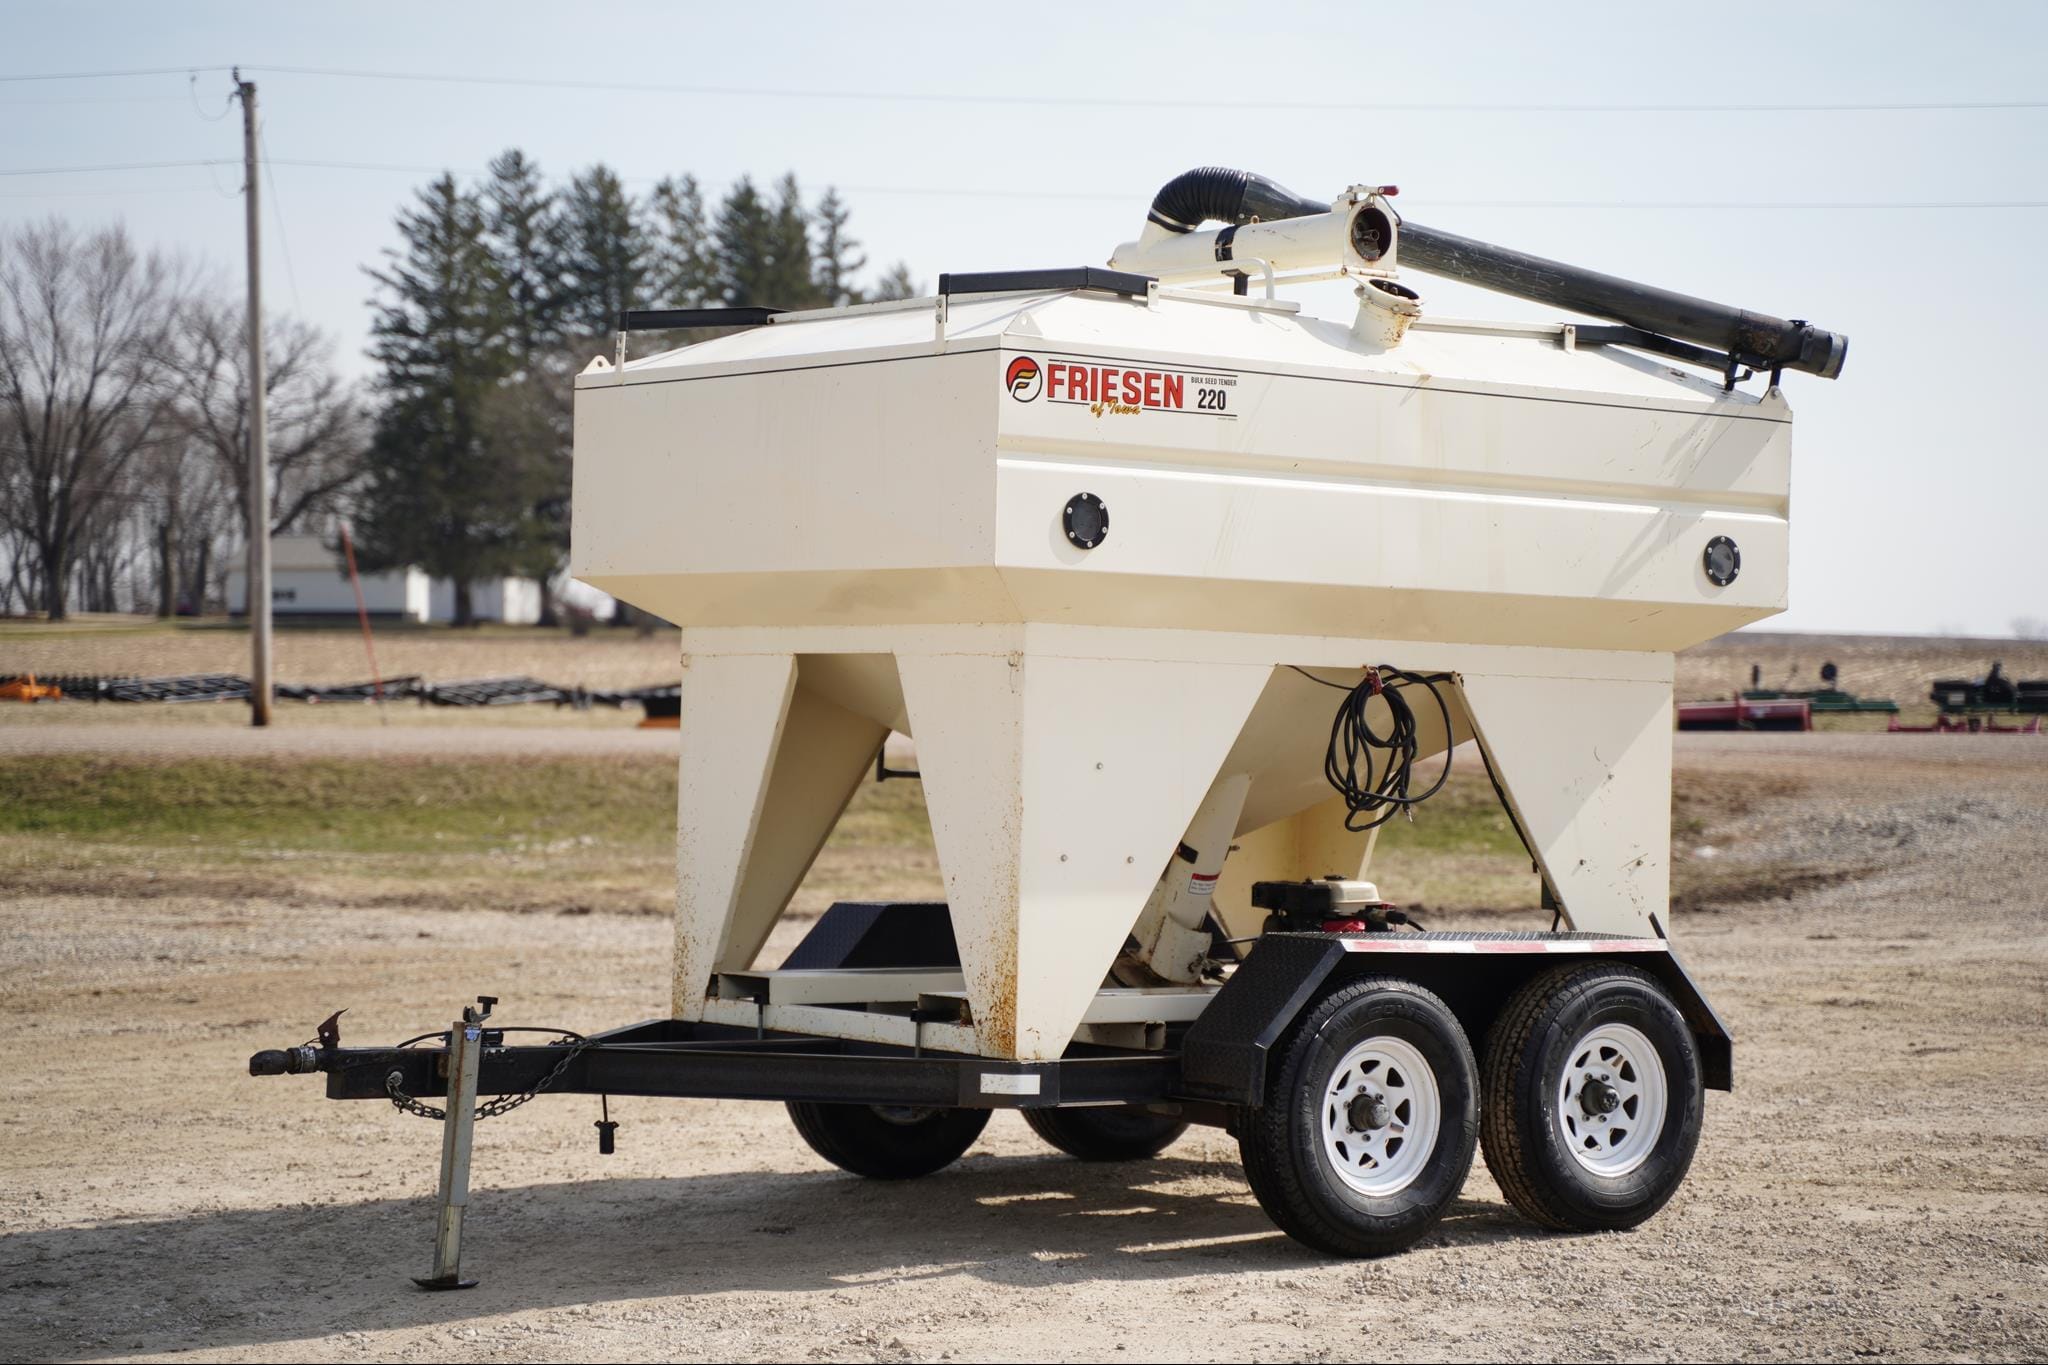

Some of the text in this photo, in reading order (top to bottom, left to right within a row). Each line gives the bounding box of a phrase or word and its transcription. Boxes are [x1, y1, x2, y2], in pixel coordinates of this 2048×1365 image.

[1047, 363, 1184, 409] FRIESEN
[1191, 376, 1237, 386] BULK SEED TENDER
[1197, 388, 1226, 411] 220
[1091, 401, 1105, 419] of
